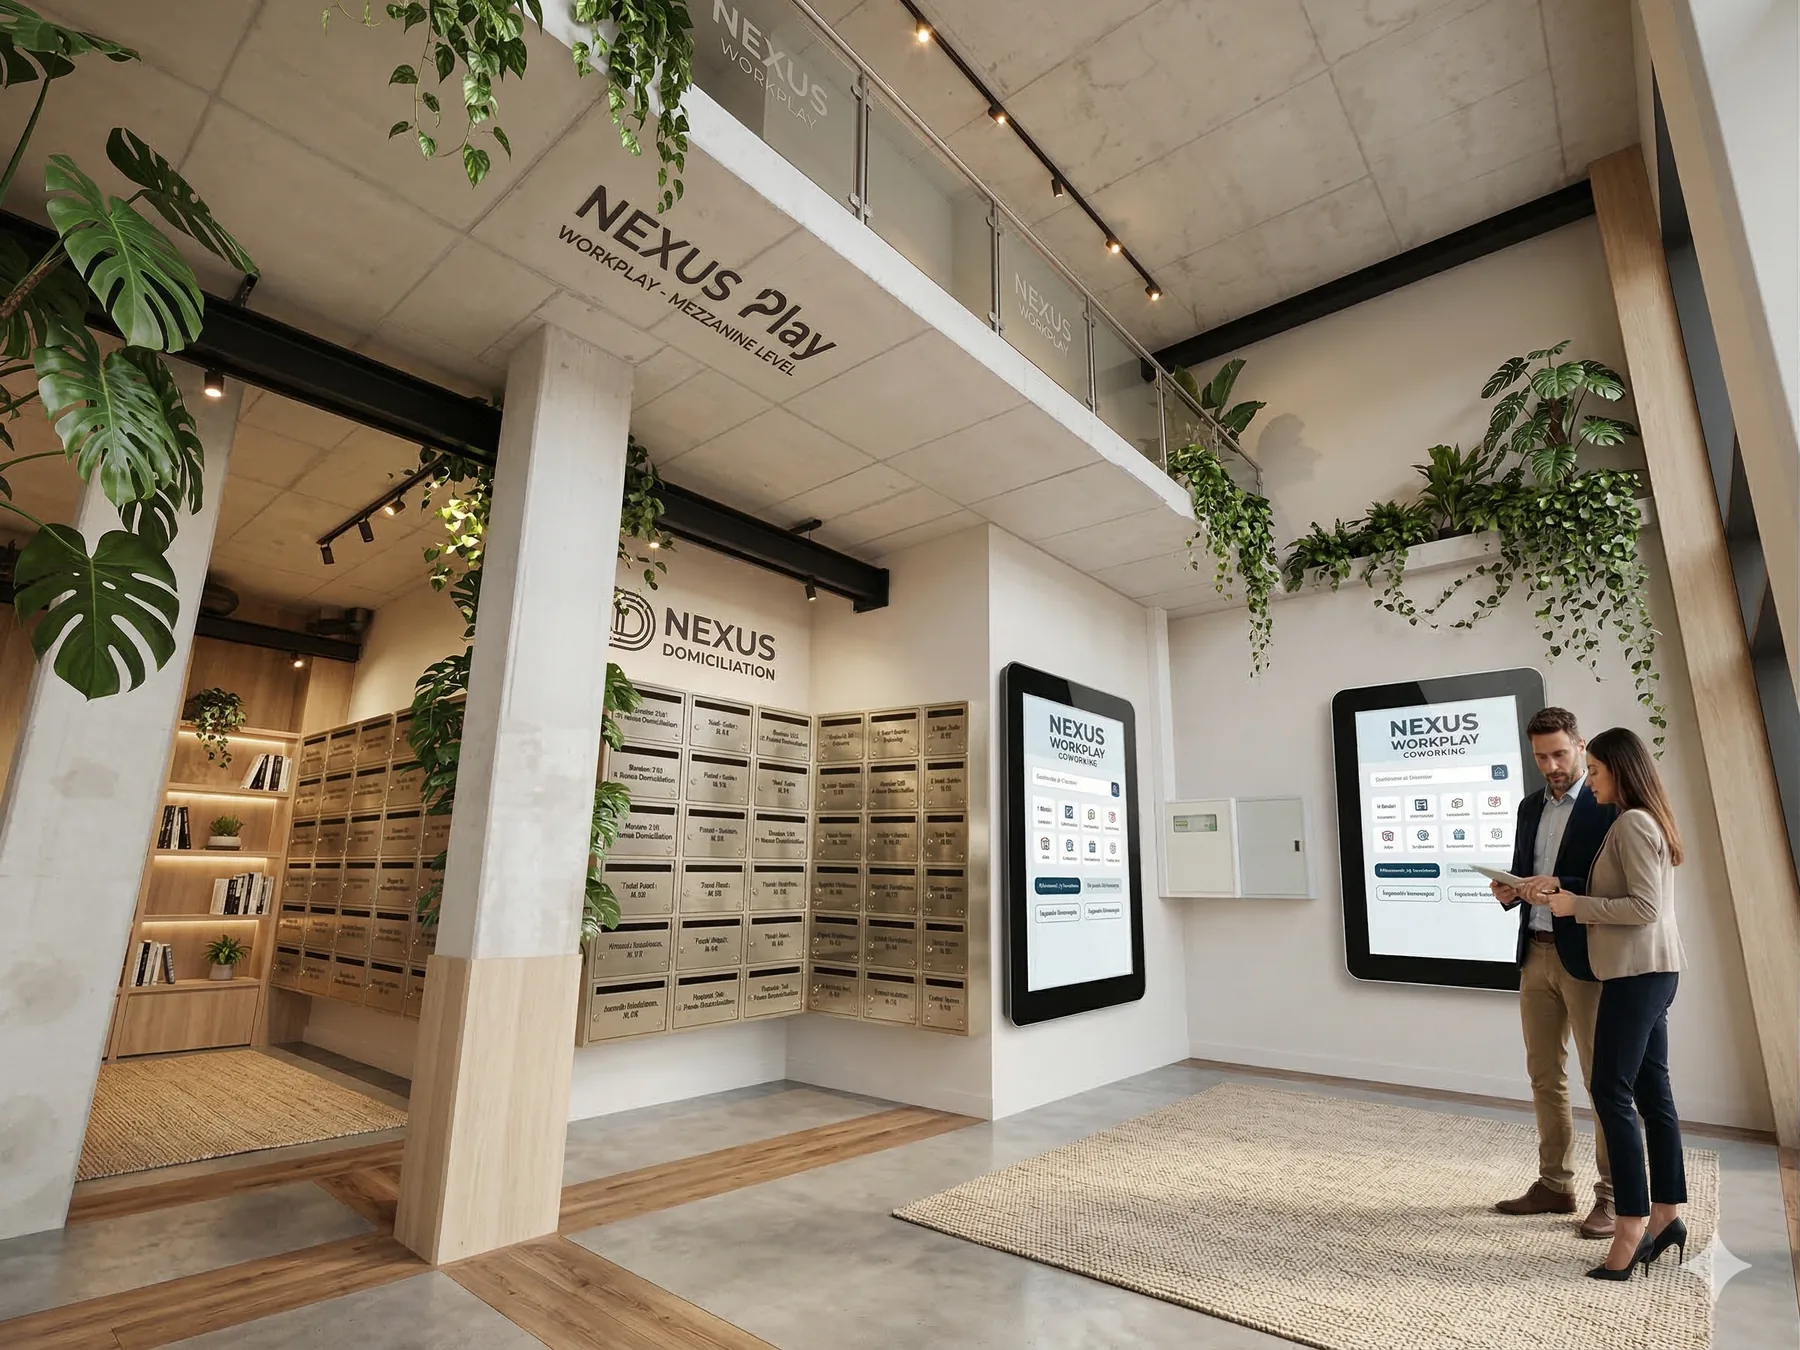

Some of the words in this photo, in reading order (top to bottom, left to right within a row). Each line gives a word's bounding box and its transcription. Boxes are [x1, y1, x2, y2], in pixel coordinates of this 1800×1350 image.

[712, 0, 828, 117] NEXUS
[720, 36, 817, 129] WORKPLAY
[575, 184, 743, 302] NEXUS
[738, 288, 838, 361] Play
[558, 224, 661, 292] WORKPLAY
[667, 292, 758, 352] MEZZANINE
[754, 345, 797, 377] LEVEL
[1015, 271, 1072, 342] NEXUS
[1018, 301, 1069, 356] WORKPLAY
[662, 643, 775, 681] DOMICILIATION
[664, 607, 776, 662] NEXUS
[1049, 714, 1105, 746] NEXUS
[1049, 736, 1106, 759] WORKPLAY
[1390, 712, 1480, 737] NEXUS
[1391, 733, 1480, 750] WORKPLAY
[1403, 748, 1466, 759] COWORKING
